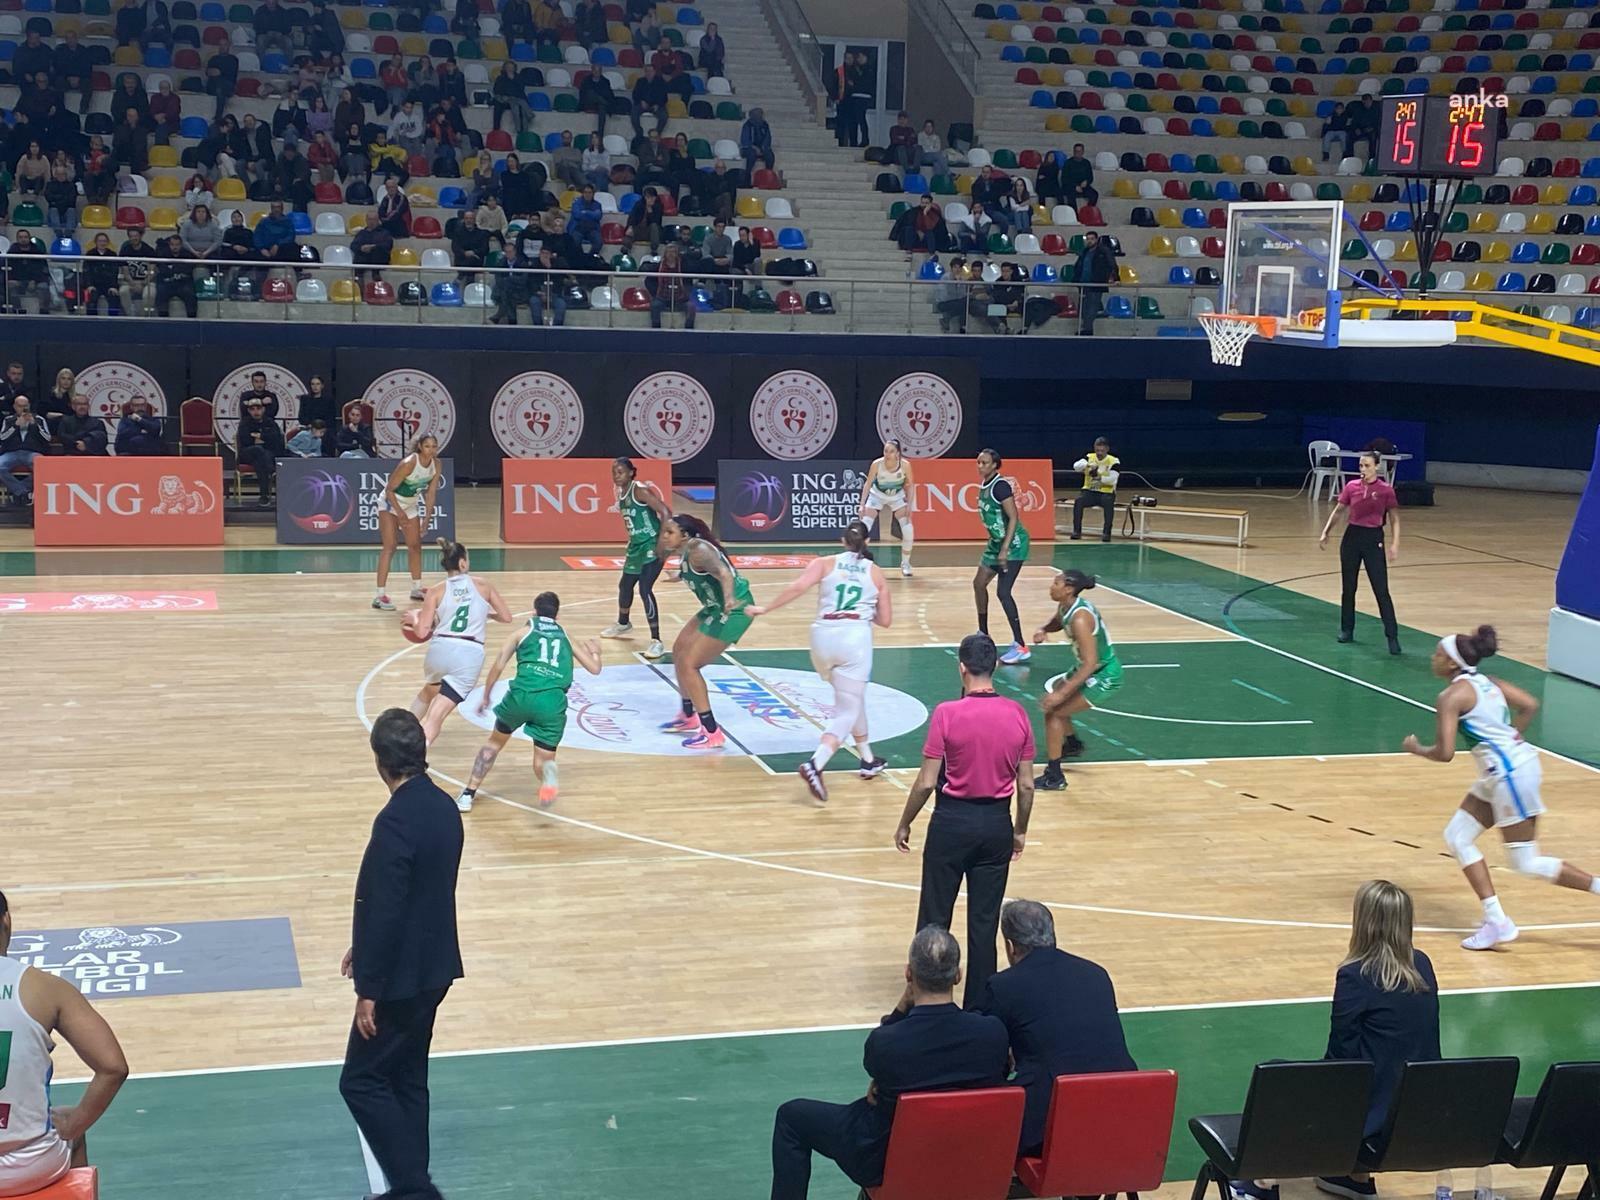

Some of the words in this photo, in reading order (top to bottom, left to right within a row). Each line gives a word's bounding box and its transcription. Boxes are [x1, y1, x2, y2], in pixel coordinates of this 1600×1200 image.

[1395, 101, 1417, 122] 2:47
[1392, 121, 1417, 165] 15
[1446, 122, 1486, 167] 15
[359, 472, 390, 490] IN
[792, 473, 837, 490] ING
[43, 482, 144, 516] ING
[511, 483, 601, 514] ING
[791, 492, 860, 504] KADINLAR
[792, 505, 859, 516] BASKETBO
[792, 515, 837, 529] SÜPER
[834, 583, 863, 612] 12
[450, 605, 470, 633] 8
[536, 637, 562, 668] 11
